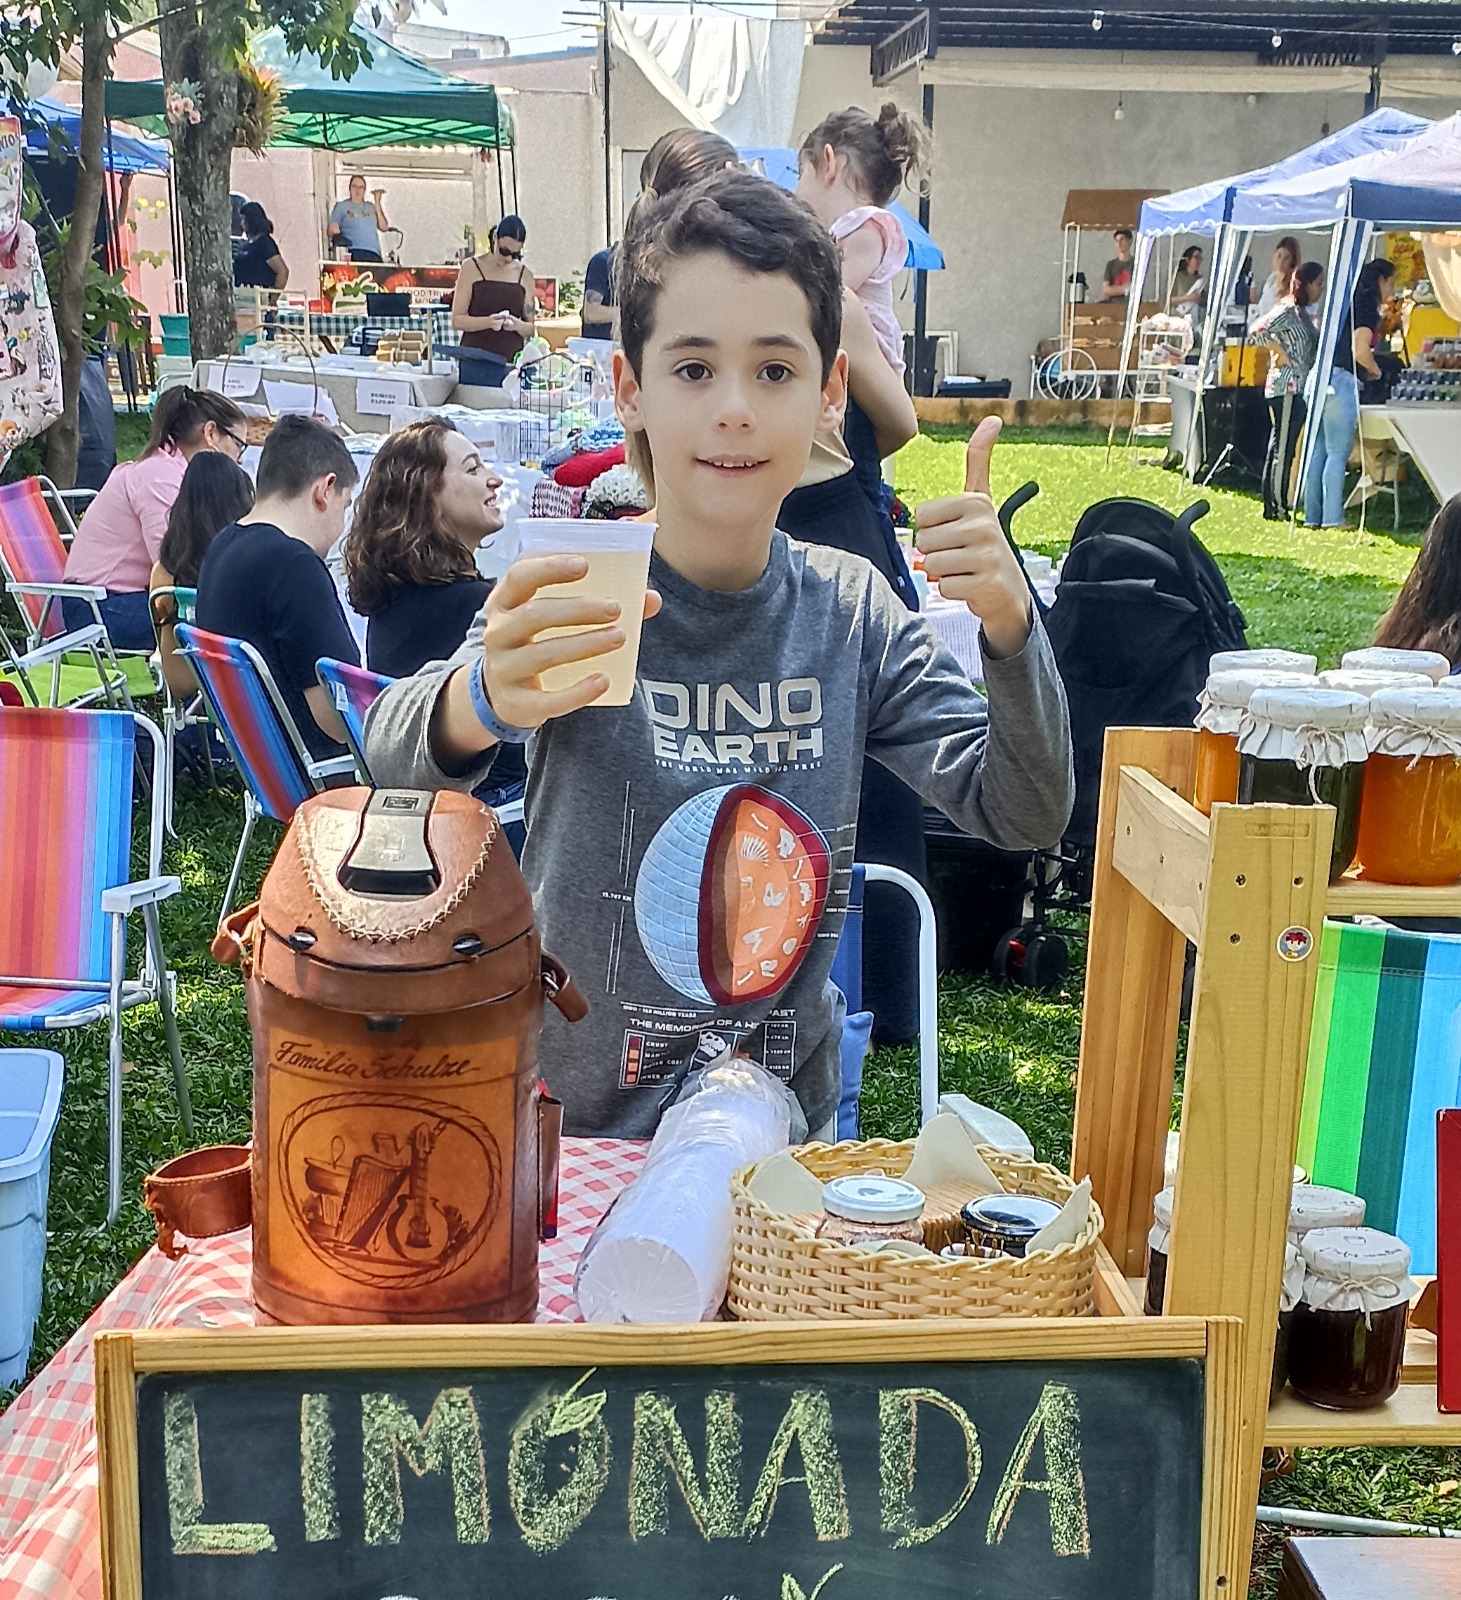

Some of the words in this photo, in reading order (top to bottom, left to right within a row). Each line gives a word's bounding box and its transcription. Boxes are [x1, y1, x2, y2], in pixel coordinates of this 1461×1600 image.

[642, 677, 822, 731] DINO
[652, 725, 824, 764] EARTH
[655, 759, 673, 769] THE
[378, 853, 406, 862] OPEN
[630, 1017, 653, 1028] THE
[769, 1009, 796, 1017] AST
[275, 1041, 358, 1077] Familia
[361, 1053, 481, 1079] Schulze
[164, 1382, 1091, 1557] LIMONADA
